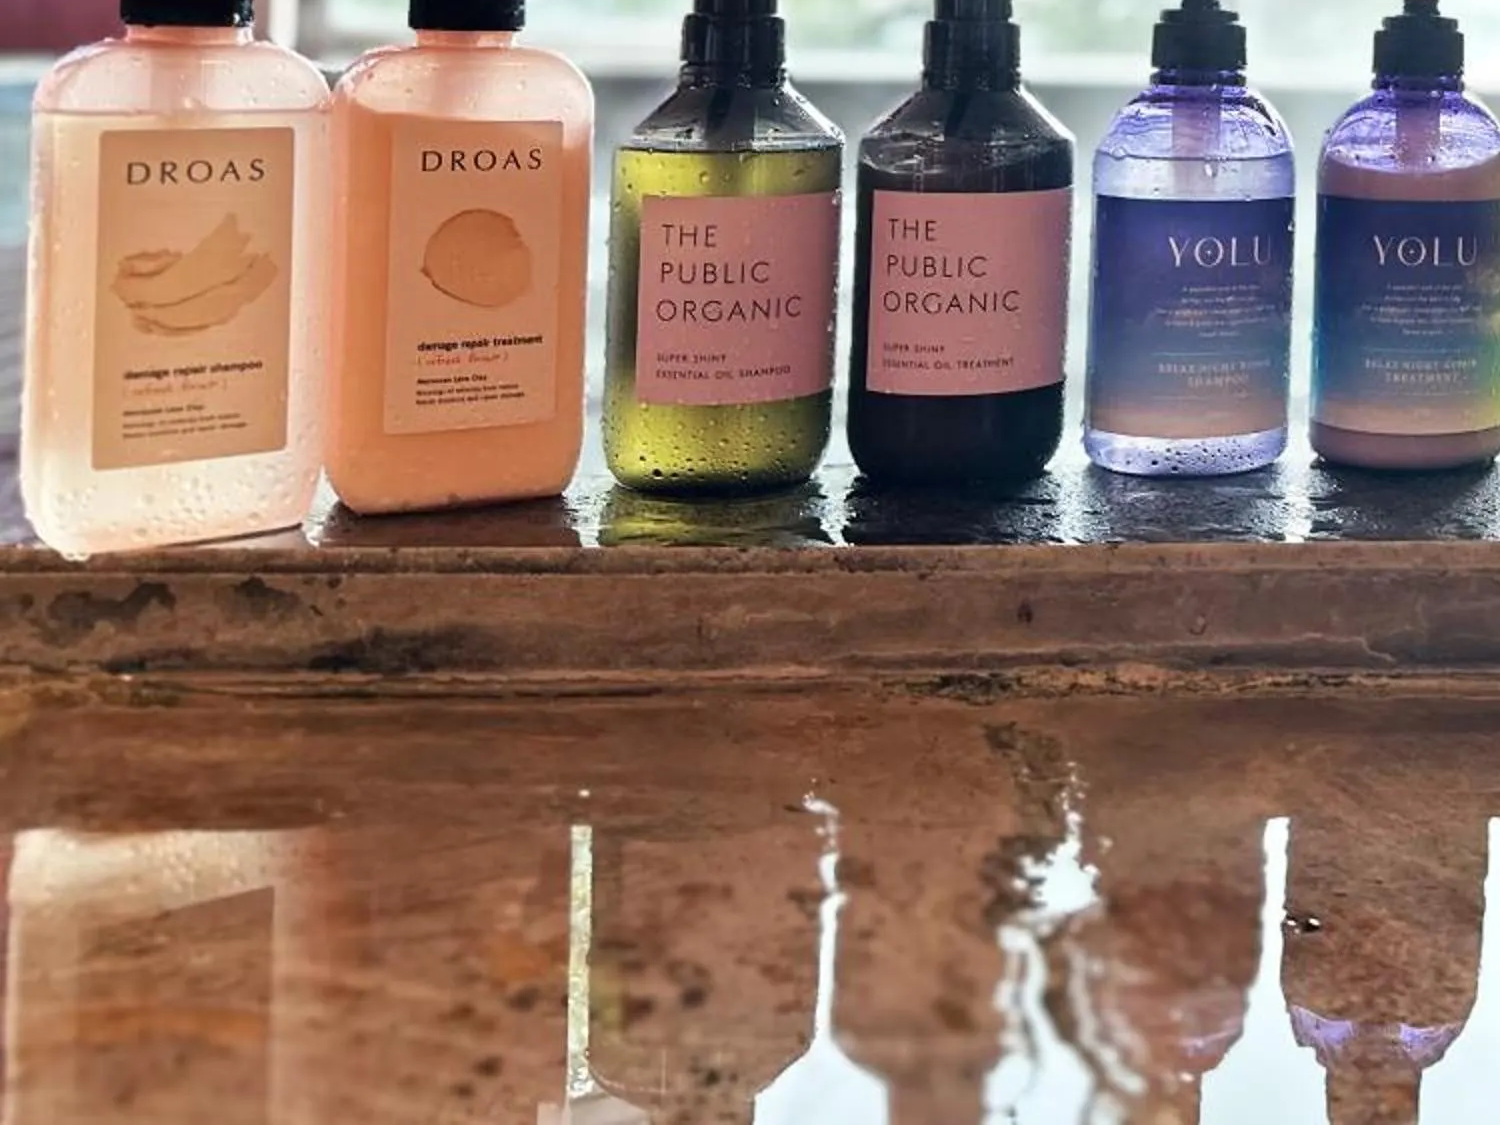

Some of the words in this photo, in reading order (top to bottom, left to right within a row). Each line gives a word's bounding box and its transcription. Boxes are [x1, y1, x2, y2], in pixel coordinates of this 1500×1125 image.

[127, 158, 265, 186] DROAS
[422, 148, 541, 172] DROAS
[662, 224, 718, 248] THE
[888, 218, 937, 242] THE
[1168, 235, 1271, 267] YOLU
[1373, 234, 1478, 266] YOLU
[660, 261, 770, 284] PUBLIC
[886, 254, 988, 278] PUBLIC
[656, 296, 802, 322] ORGANIC
[883, 290, 1021, 315] ORGANIC
[461, 339, 489, 350] repair
[493, 335, 543, 347] treatment
[210, 360, 263, 374] shampoo
[657, 354, 687, 363] SUPER
[957, 357, 1014, 369] TREATMENT
[740, 365, 791, 377] SHAMPOO
